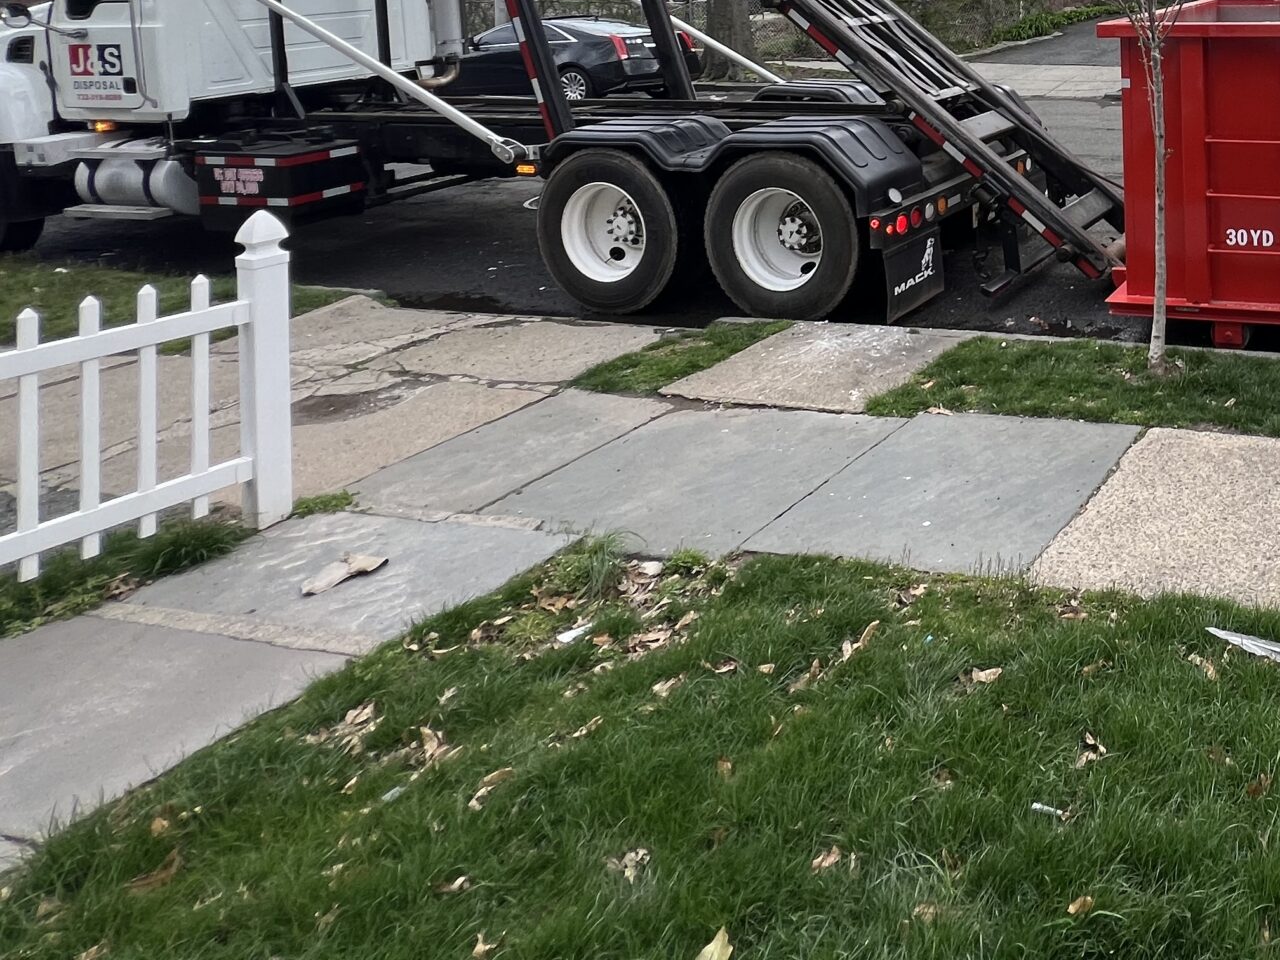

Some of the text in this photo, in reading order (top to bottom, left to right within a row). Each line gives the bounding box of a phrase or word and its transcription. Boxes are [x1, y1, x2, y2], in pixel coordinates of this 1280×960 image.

[71, 47, 121, 74] J&S
[73, 80, 122, 91] DISPOSAL
[894, 266, 934, 296] MACK
